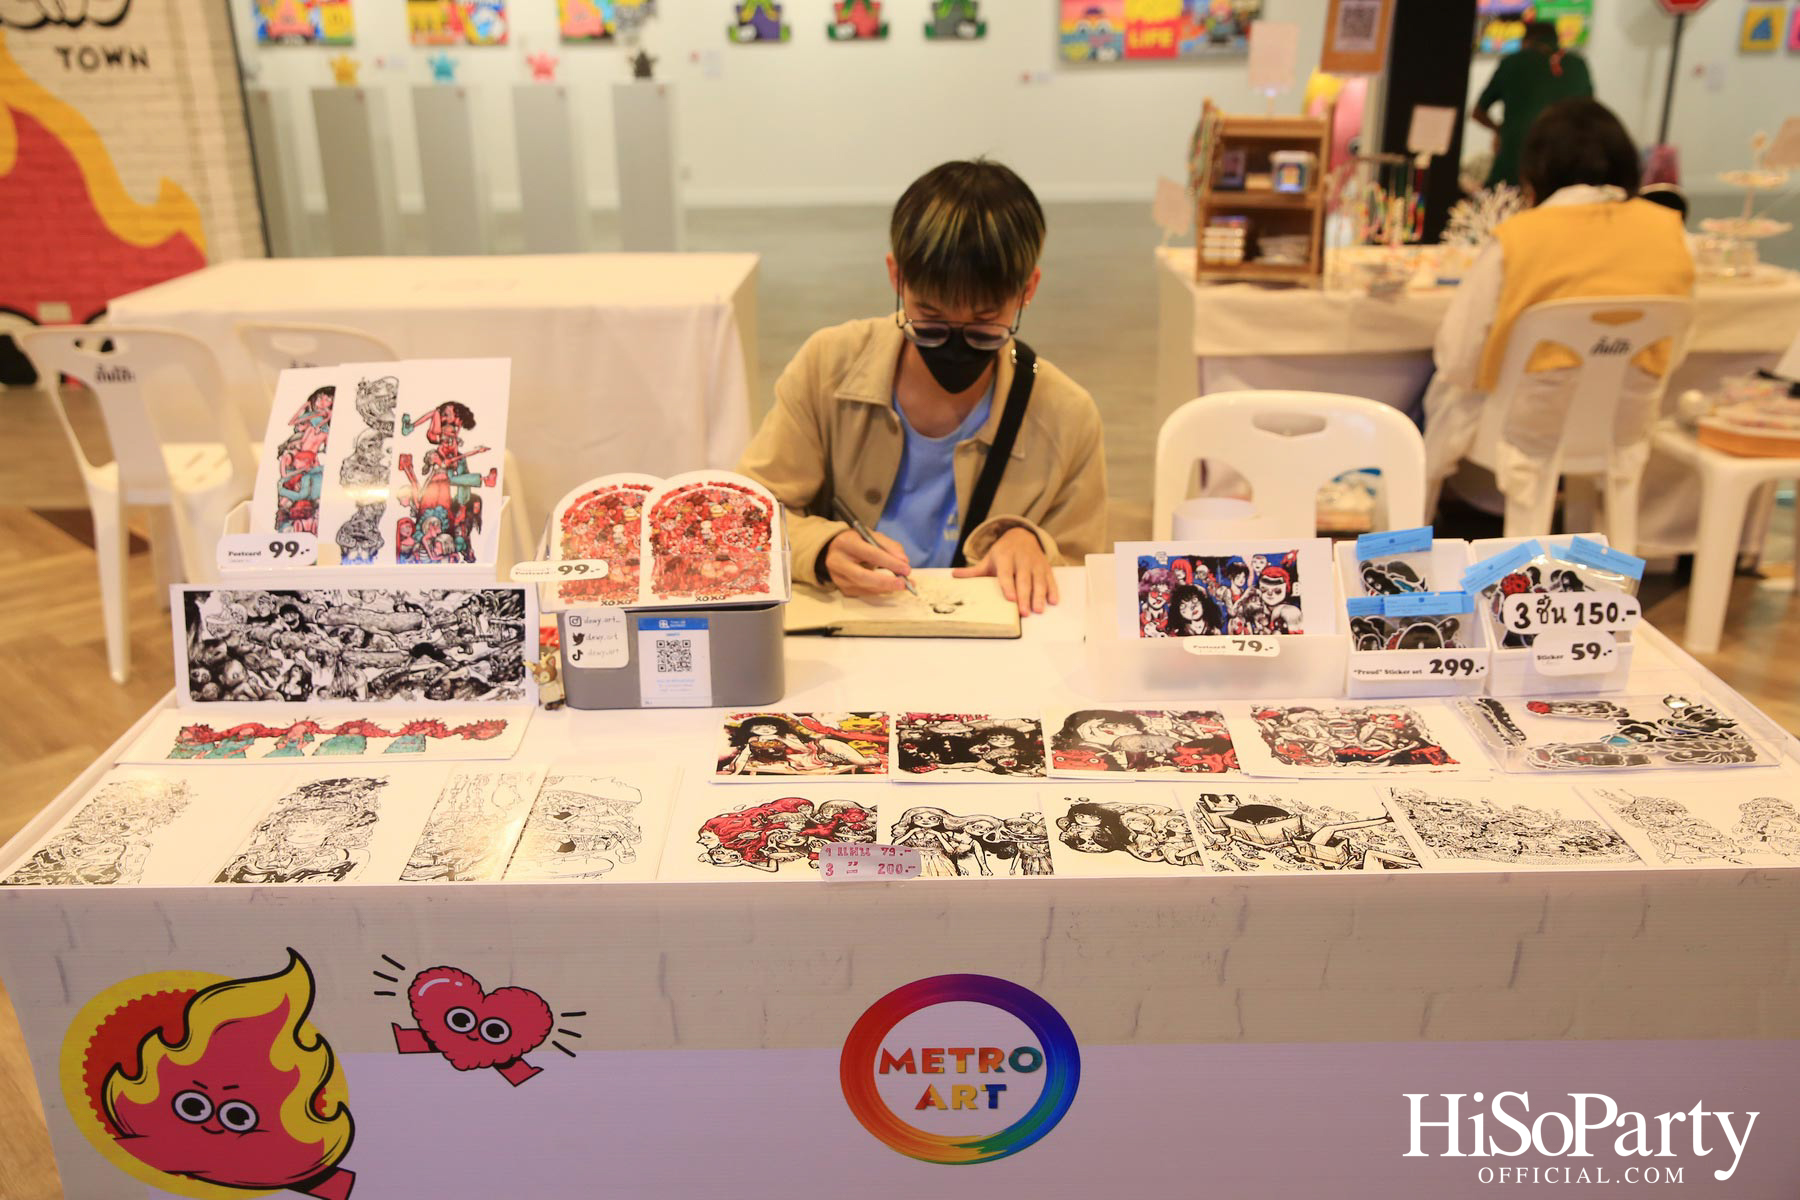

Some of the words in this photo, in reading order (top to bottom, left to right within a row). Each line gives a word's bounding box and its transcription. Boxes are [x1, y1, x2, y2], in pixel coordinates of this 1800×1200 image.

[56, 47, 149, 72] TOWN
[269, 541, 310, 558] 99.-
[558, 564, 600, 575] 99.-
[1514, 602, 1531, 629] 3
[1574, 602, 1637, 625] 150.-
[1232, 640, 1274, 652] 79.-
[1571, 642, 1612, 660] 59.-
[1429, 658, 1485, 676] 299.-
[881, 847, 912, 857] 79.-
[825, 863, 834, 876] 3
[877, 863, 916, 875] 200.-
[878, 1046, 1043, 1074] METRO
[914, 1083, 1007, 1110] ART
